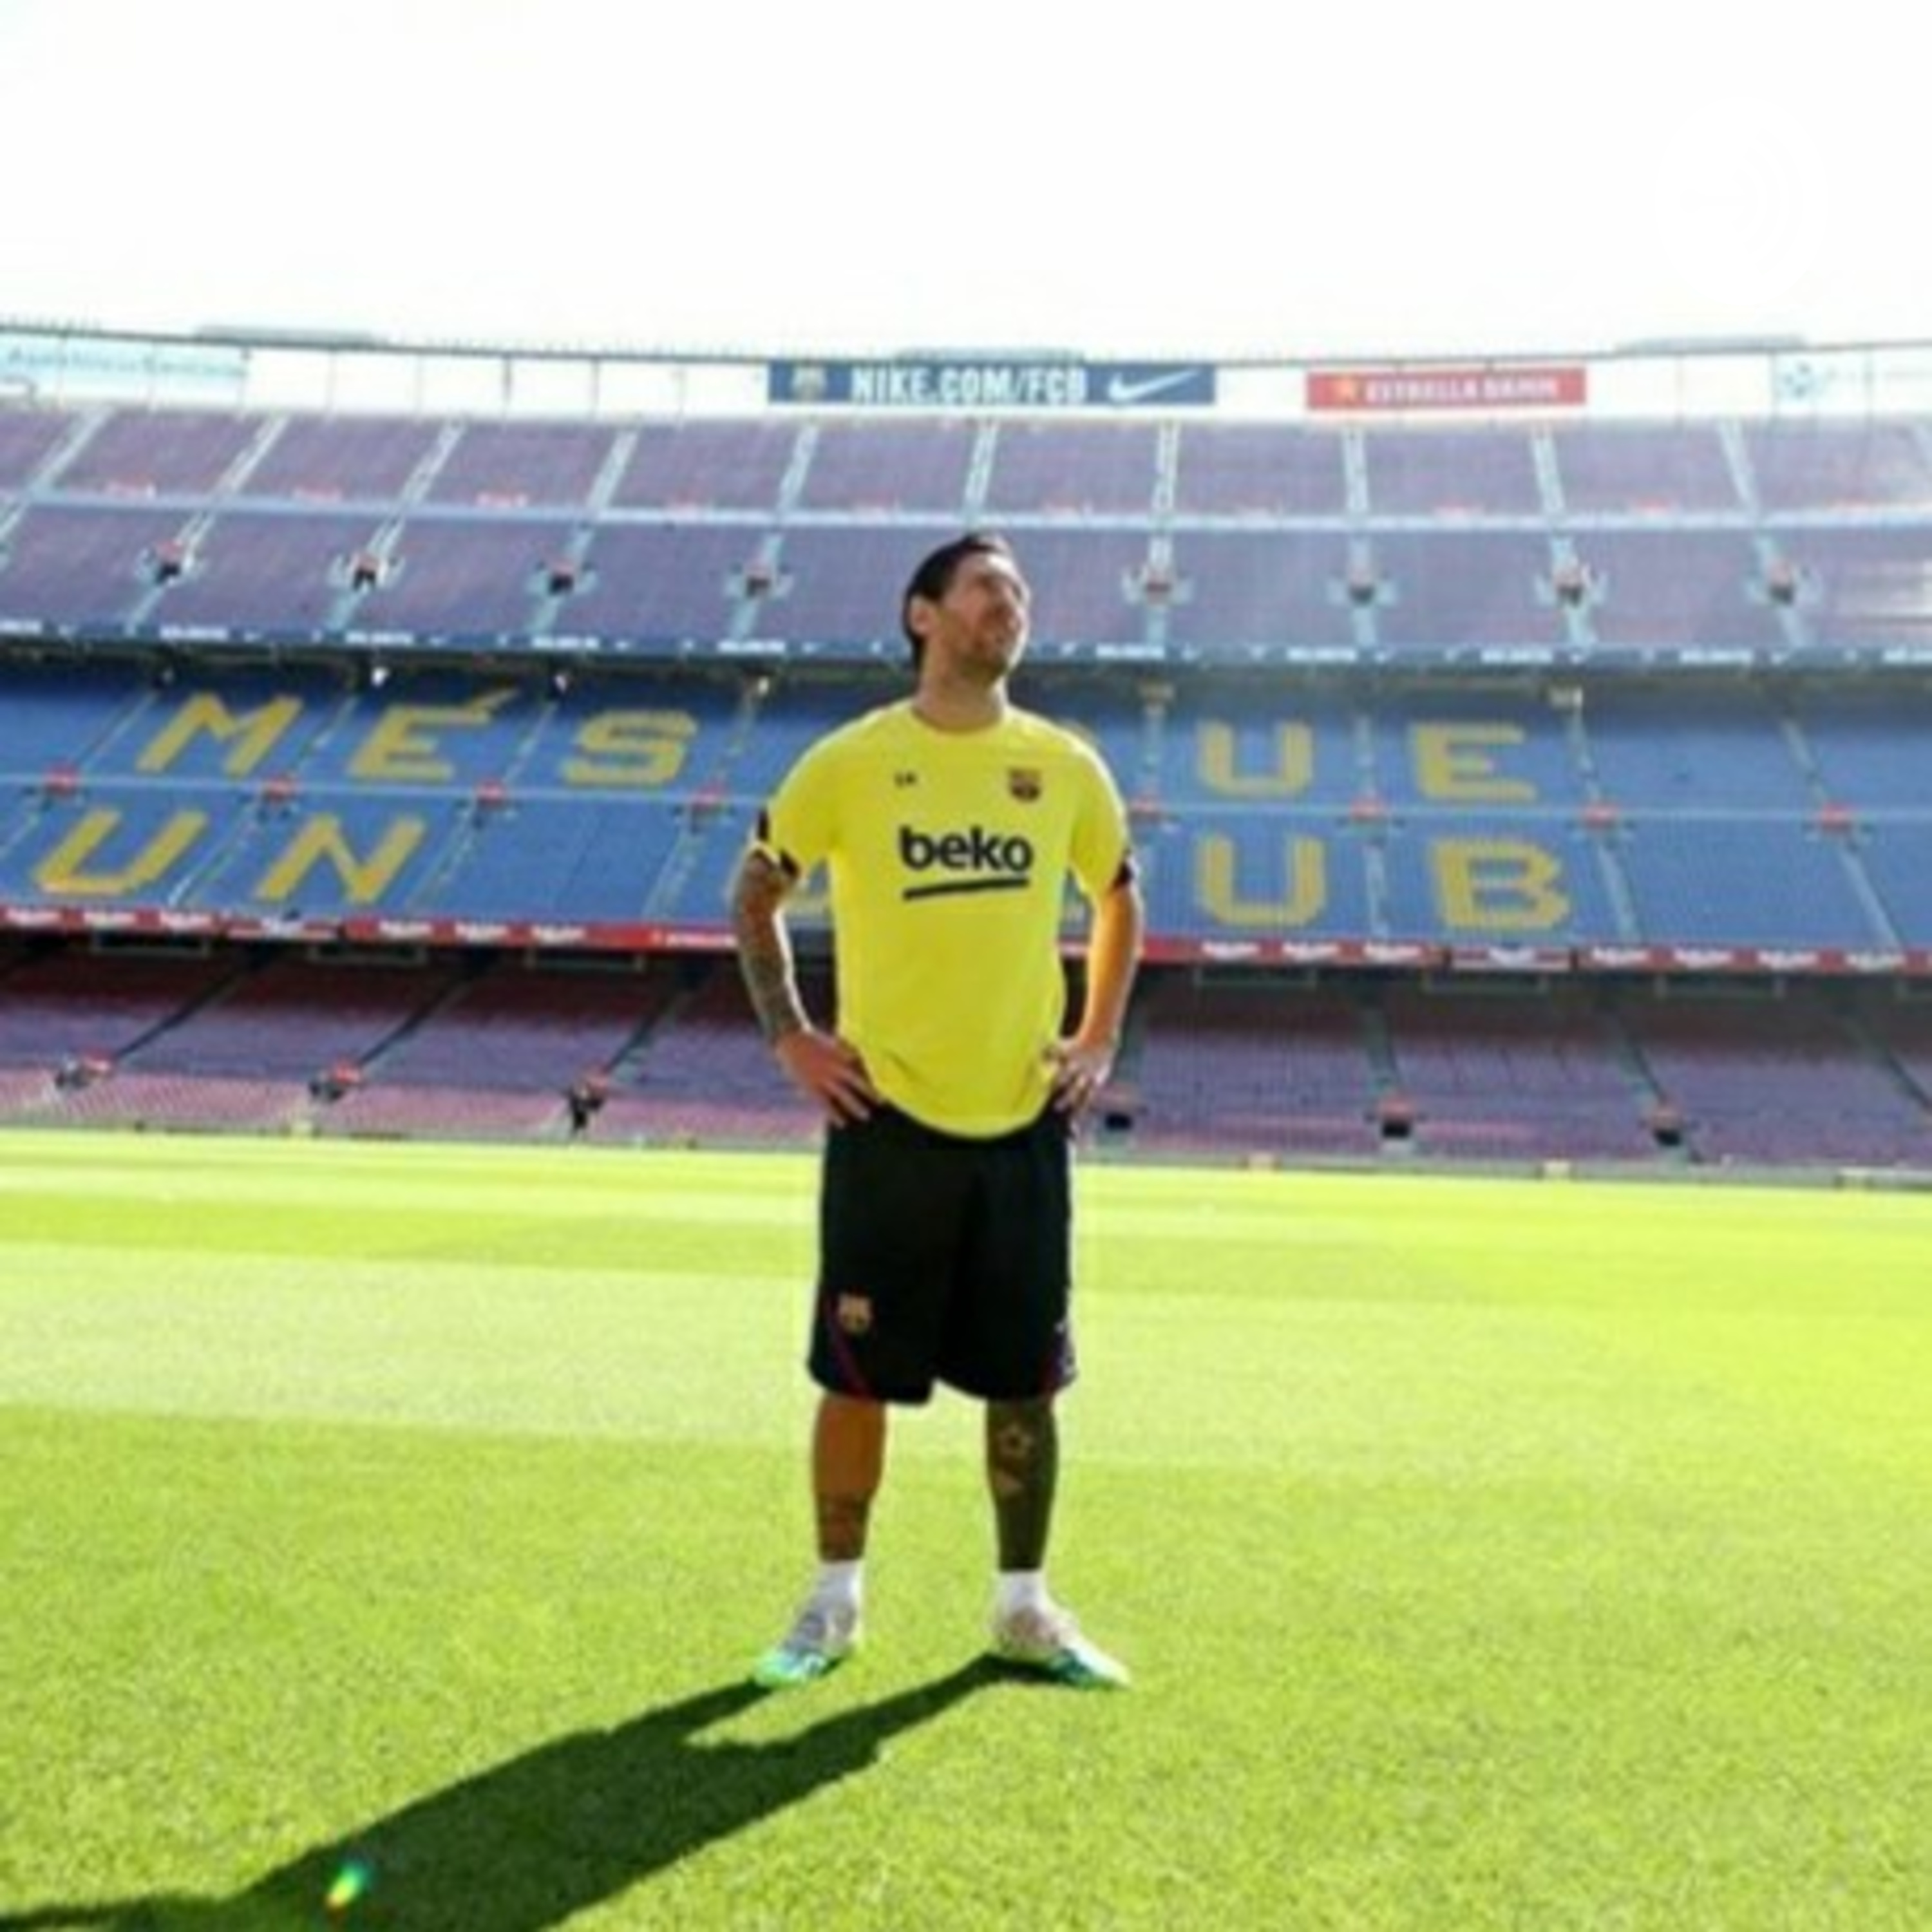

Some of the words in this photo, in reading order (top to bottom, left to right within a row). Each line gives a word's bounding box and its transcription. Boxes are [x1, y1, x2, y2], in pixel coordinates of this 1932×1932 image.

[851, 367, 1086, 403] NIKE.COM/FCB
[1197, 721, 1538, 800] UE
[31, 810, 426, 904] UN
[899, 824, 1034, 872] beko
